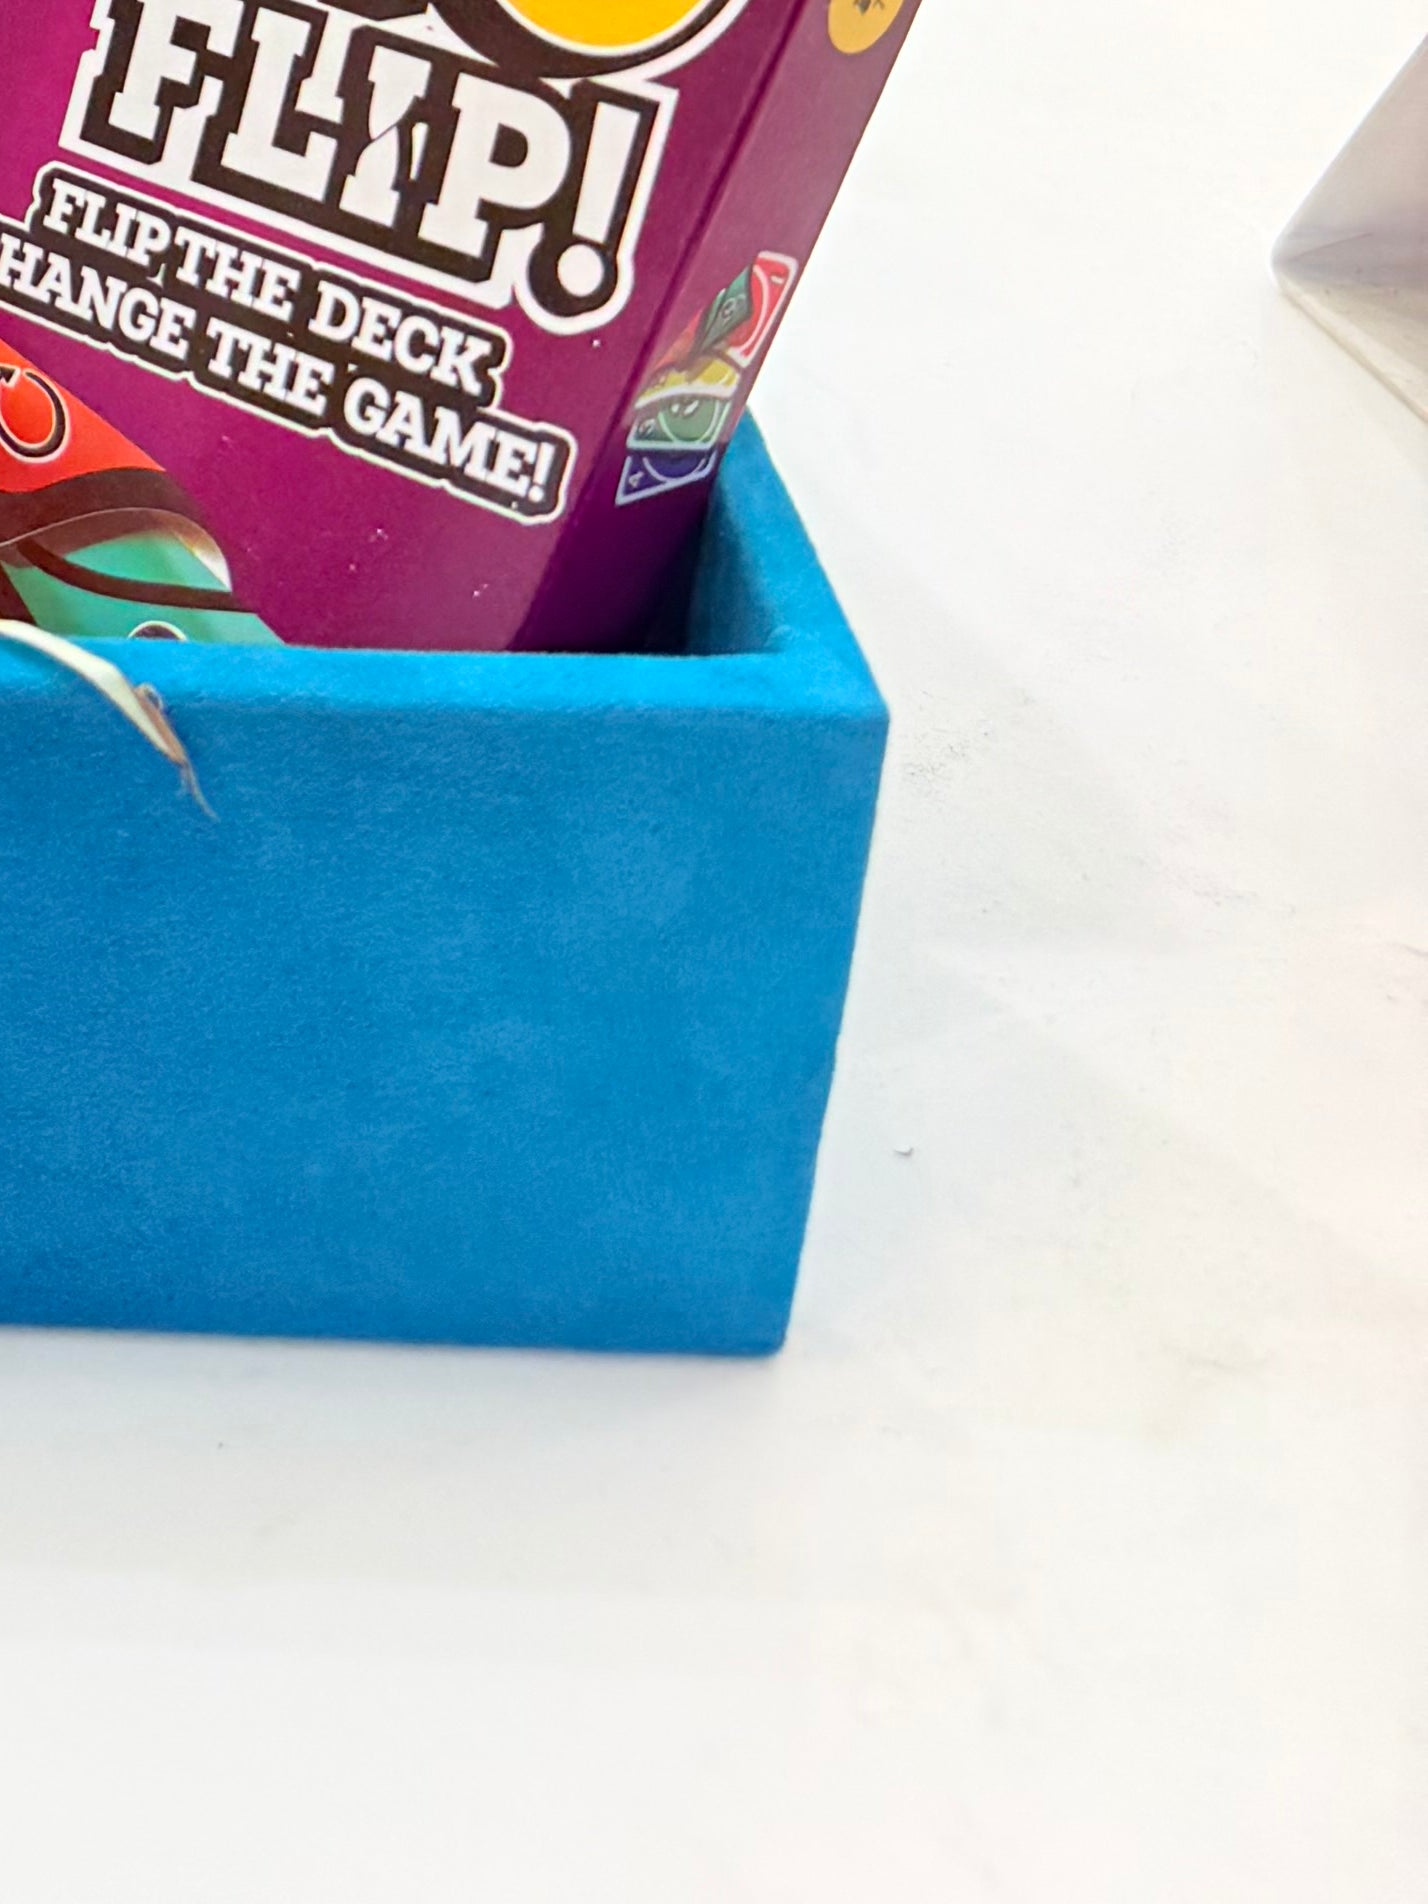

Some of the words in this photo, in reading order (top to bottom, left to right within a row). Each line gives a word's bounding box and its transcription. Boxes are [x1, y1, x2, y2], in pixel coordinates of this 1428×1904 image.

[44, 176, 174, 263] FLIP
[173, 228, 303, 323] THE
[308, 280, 496, 396] DECK
[206, 314, 336, 417] THE
[344, 374, 559, 504] GAME!
